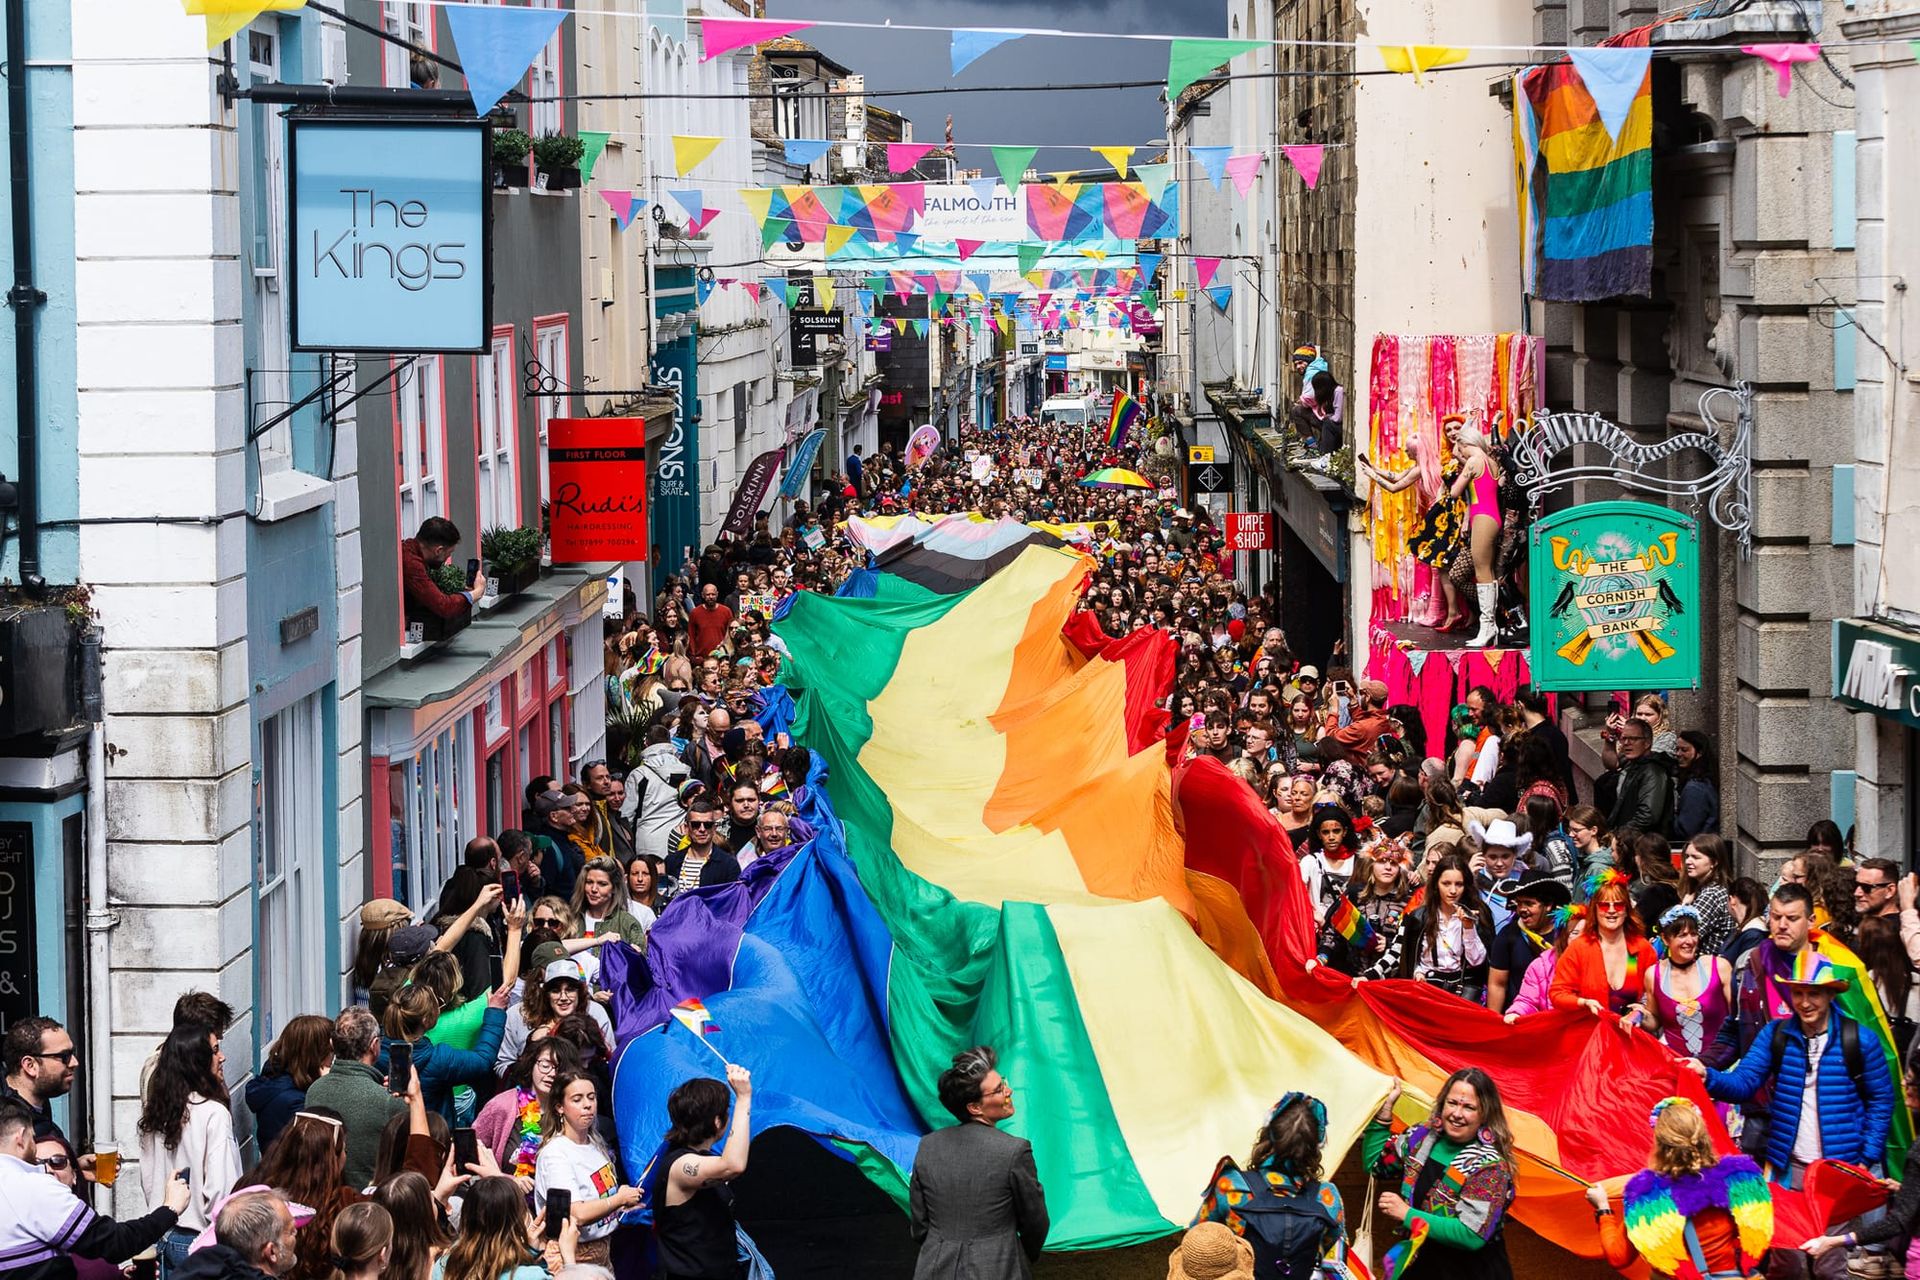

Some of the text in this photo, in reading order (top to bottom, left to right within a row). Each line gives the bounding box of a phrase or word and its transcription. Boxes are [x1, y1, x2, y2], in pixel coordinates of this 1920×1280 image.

[340, 188, 428, 229] The
[314, 228, 466, 291] Kings
[566, 450, 626, 459] FIRST FLOOR
[660, 480, 684, 488] SURF &
[660, 488, 683, 496] SKATE
[732, 463, 766, 526] SOLSKINN
[554, 482, 643, 519] Rudi's
[1237, 514, 1264, 531] VAPE
[1237, 532, 1266, 548] SHOP
[1600, 562, 1629, 574] THE
[1586, 590, 1646, 605] CORNISH
[1602, 619, 1640, 634] BANK
